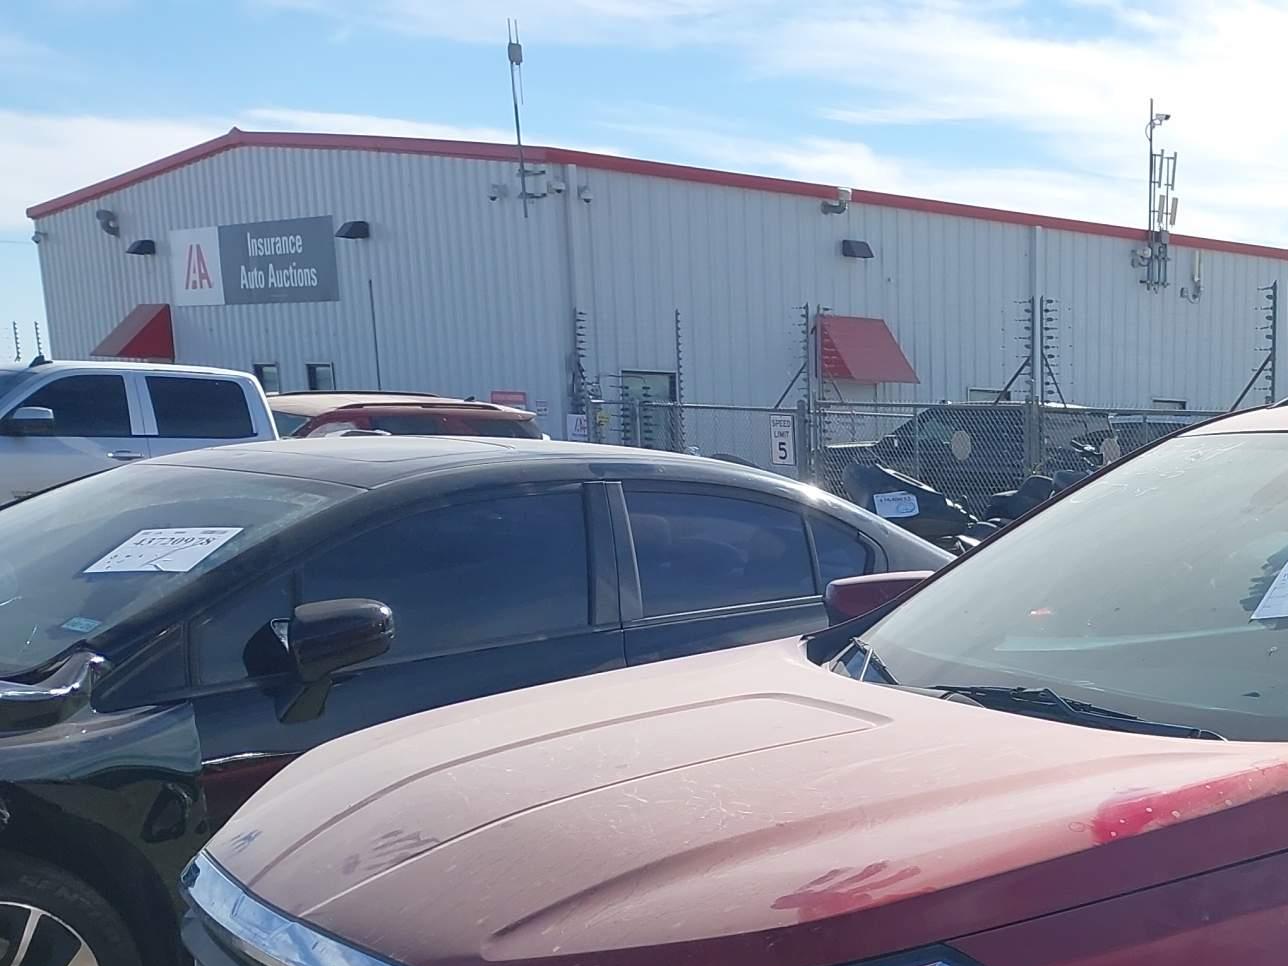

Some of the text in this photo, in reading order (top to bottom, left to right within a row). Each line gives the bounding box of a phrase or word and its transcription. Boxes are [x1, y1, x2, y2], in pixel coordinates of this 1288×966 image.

[247, 232, 303, 257] Insurance
[240, 261, 318, 289] Auto Auctions
[778, 441, 788, 460] 5
